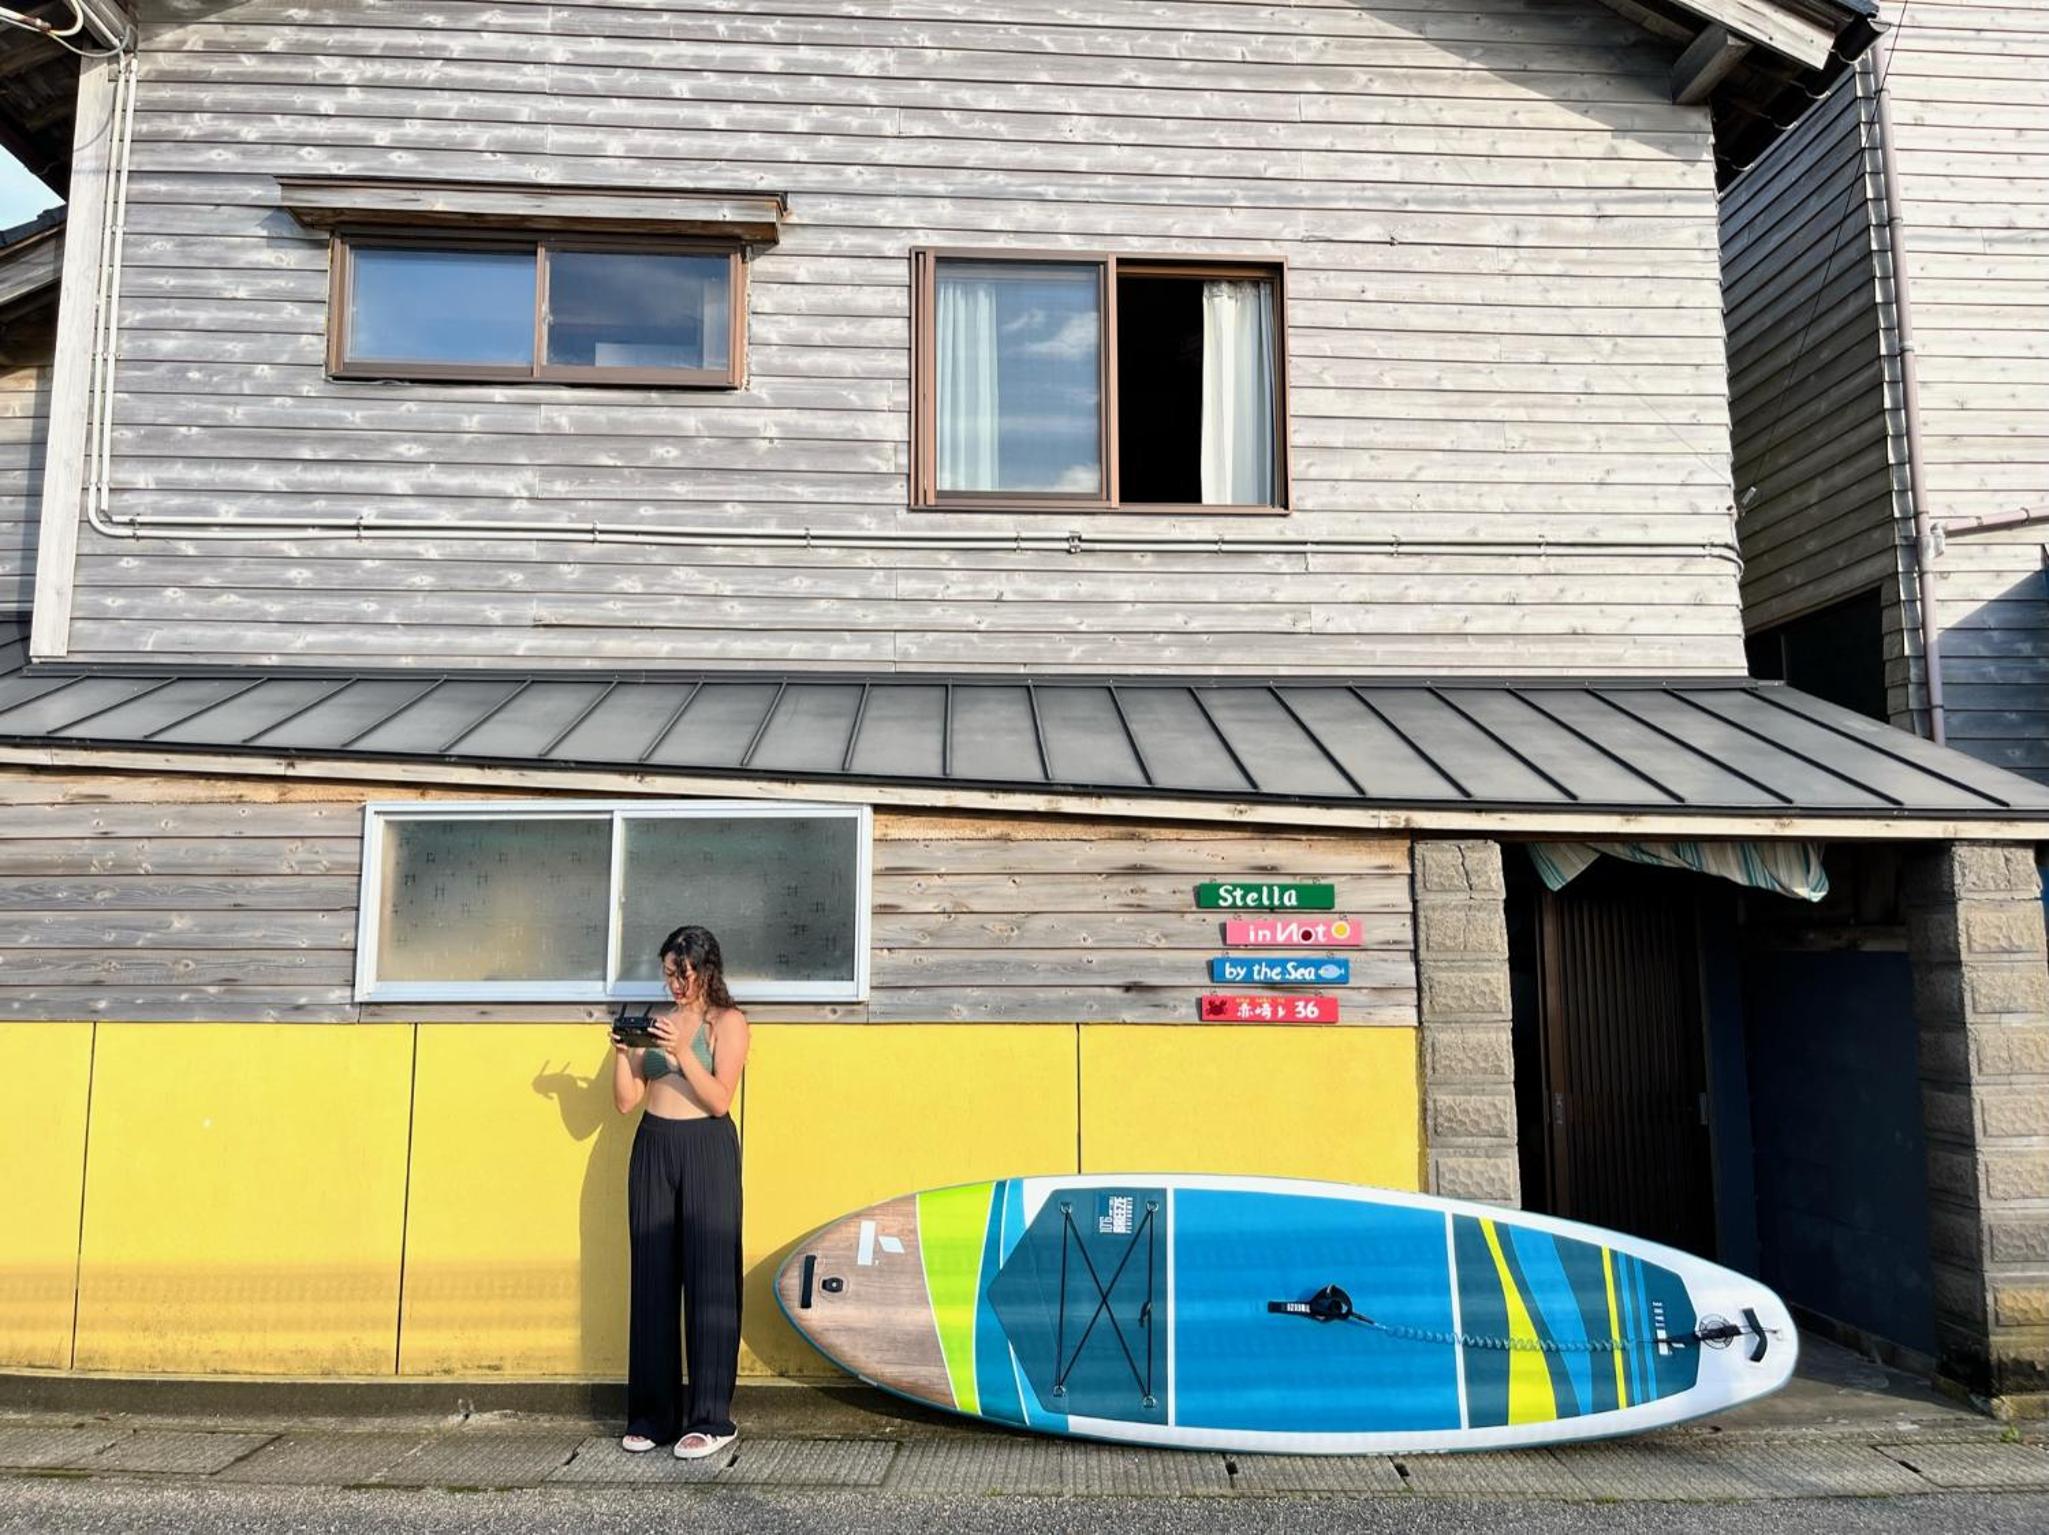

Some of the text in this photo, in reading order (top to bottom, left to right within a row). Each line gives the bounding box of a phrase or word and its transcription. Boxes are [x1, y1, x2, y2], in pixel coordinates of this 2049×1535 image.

[1218, 885, 1298, 907] Stella
[1249, 925, 1271, 943] in
[1225, 961, 1316, 981] by the Sea
[1295, 1000, 1319, 1019] 36
